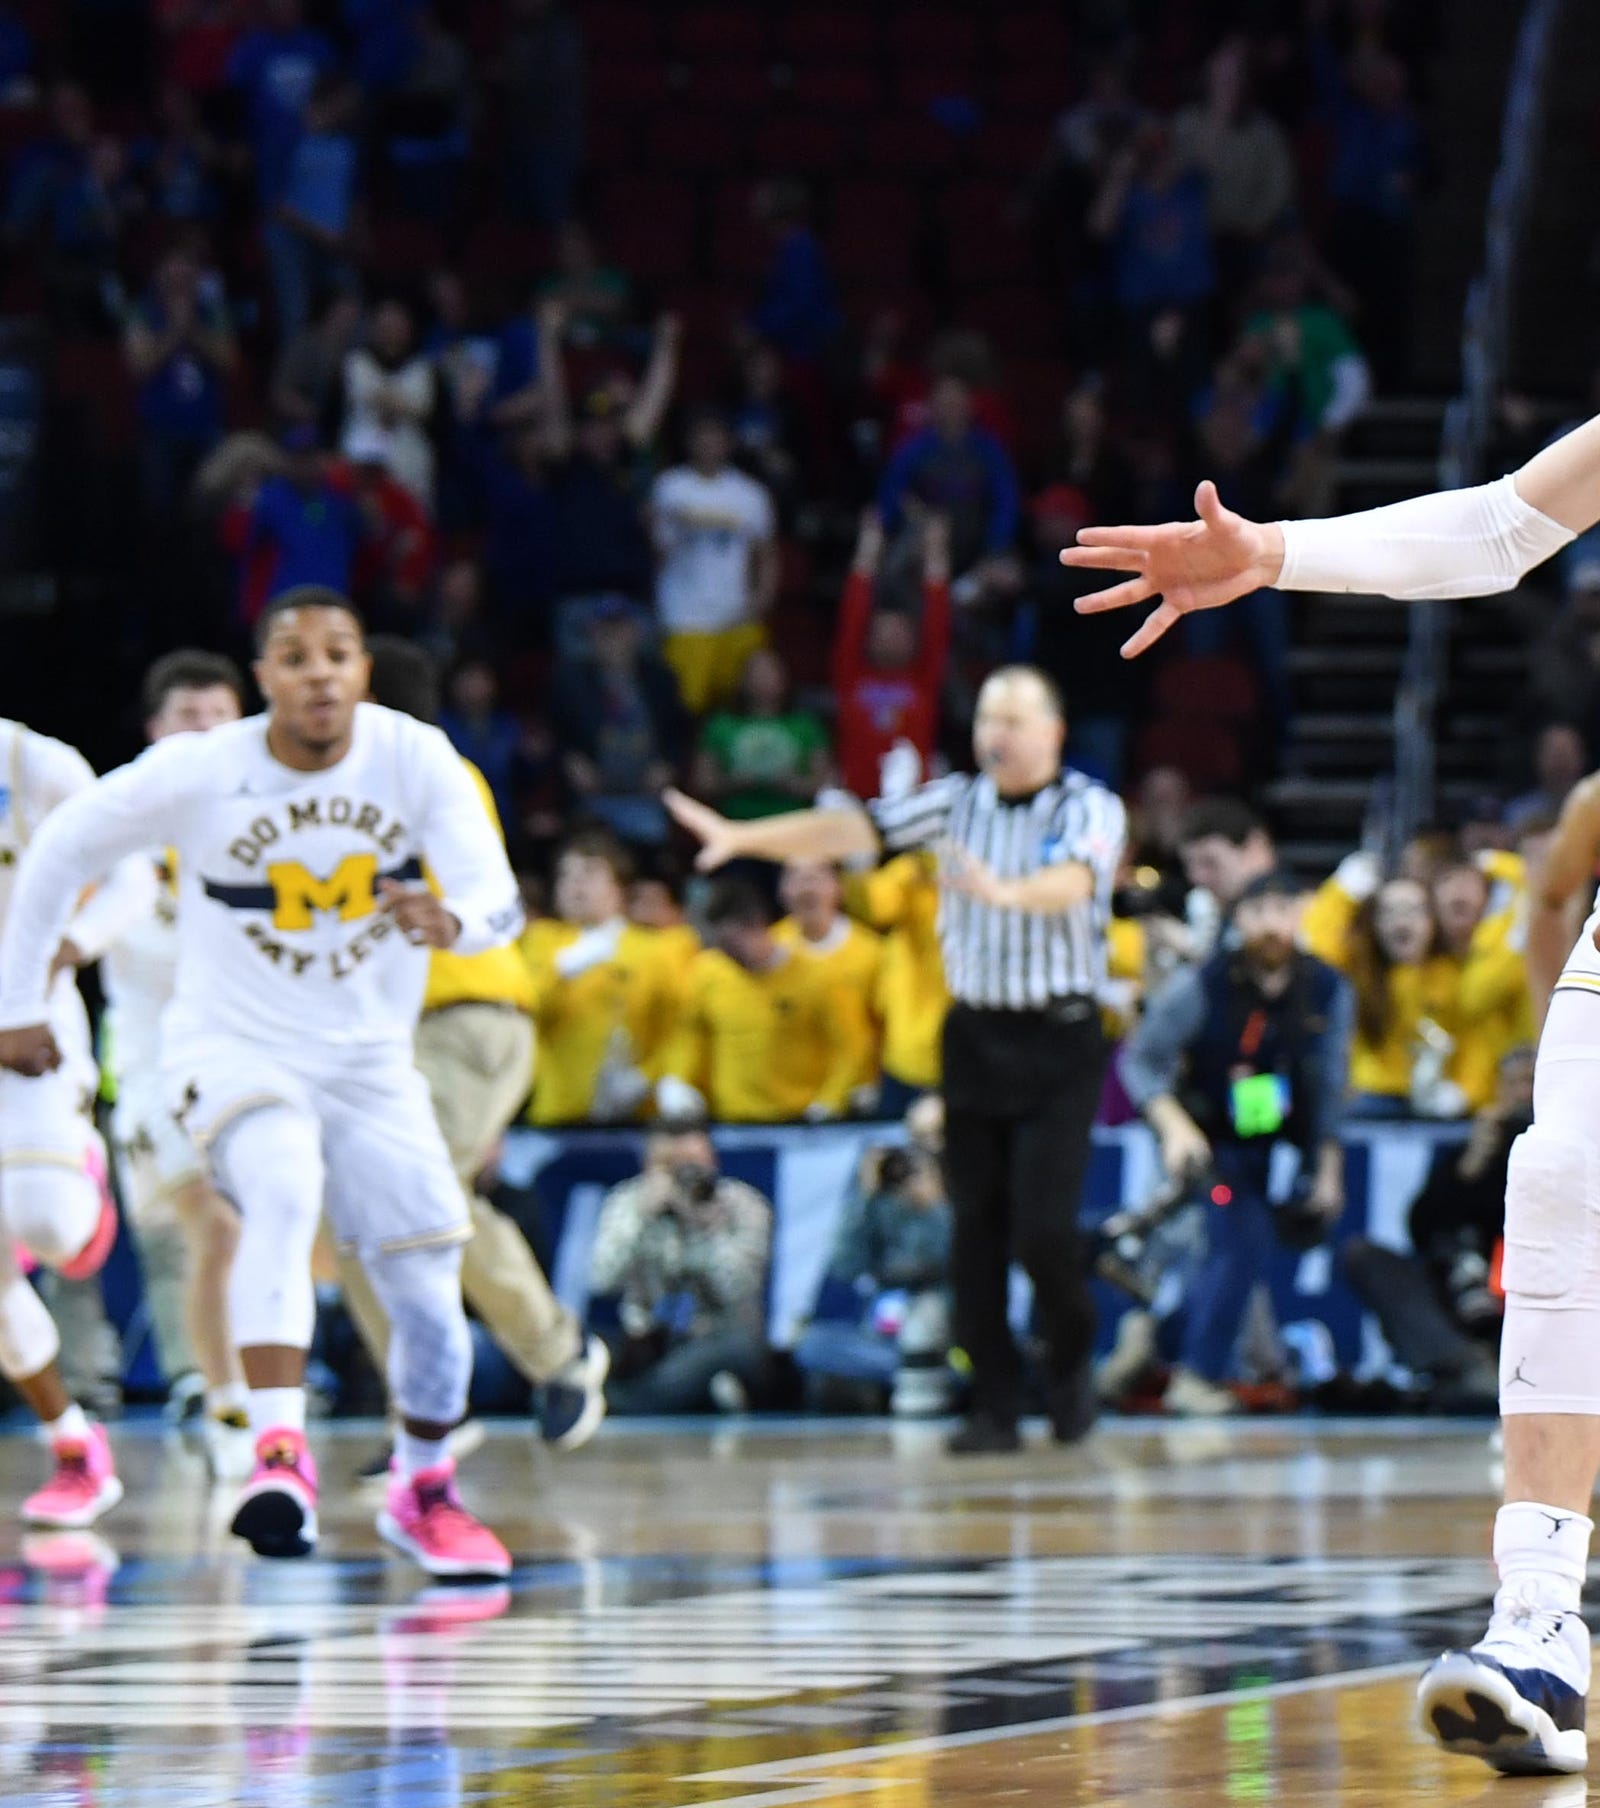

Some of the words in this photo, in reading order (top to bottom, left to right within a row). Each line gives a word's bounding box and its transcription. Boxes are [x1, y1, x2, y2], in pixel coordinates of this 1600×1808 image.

[228, 815, 281, 868] DO
[286, 796, 407, 854] MORE
[265, 852, 379, 931] M
